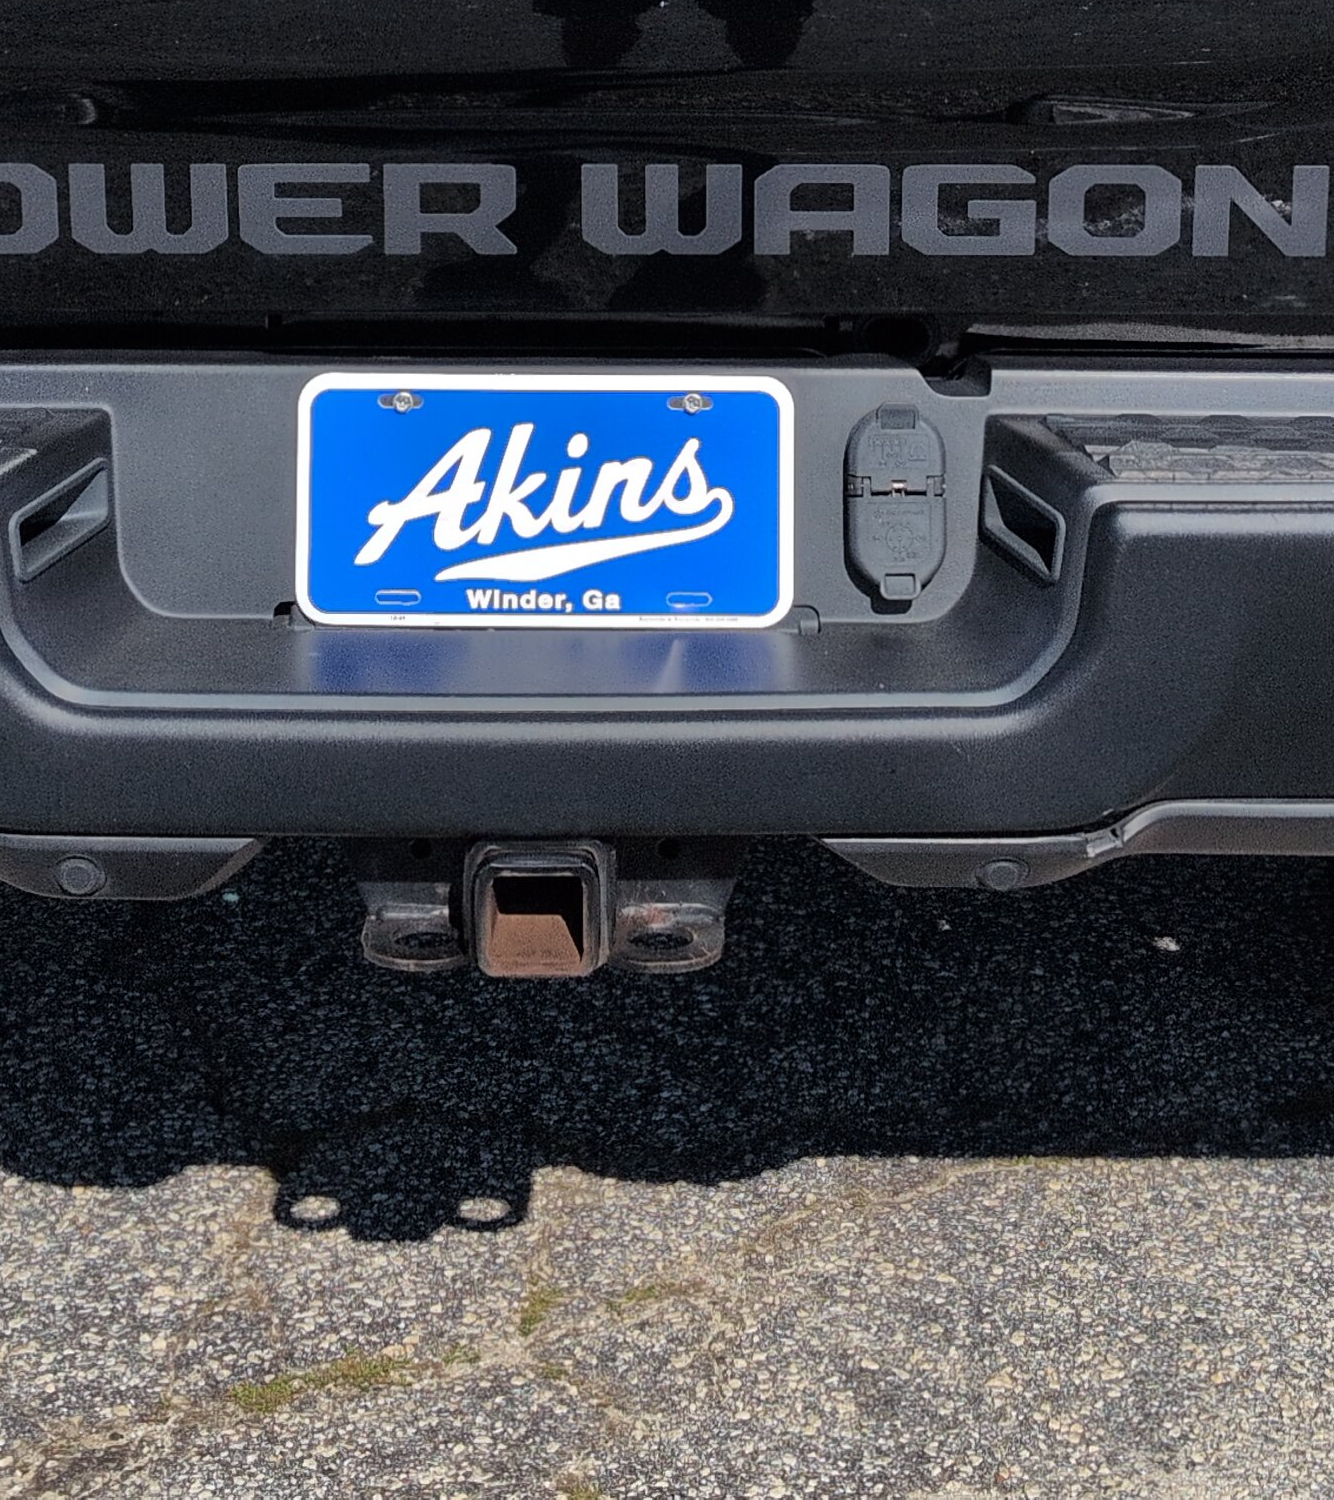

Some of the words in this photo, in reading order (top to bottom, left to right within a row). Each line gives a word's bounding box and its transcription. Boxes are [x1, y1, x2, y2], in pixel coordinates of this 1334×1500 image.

[582, 161, 1331, 258] WAGON
[354, 422, 734, 581] Akins
[582, 589, 621, 610] Ga
